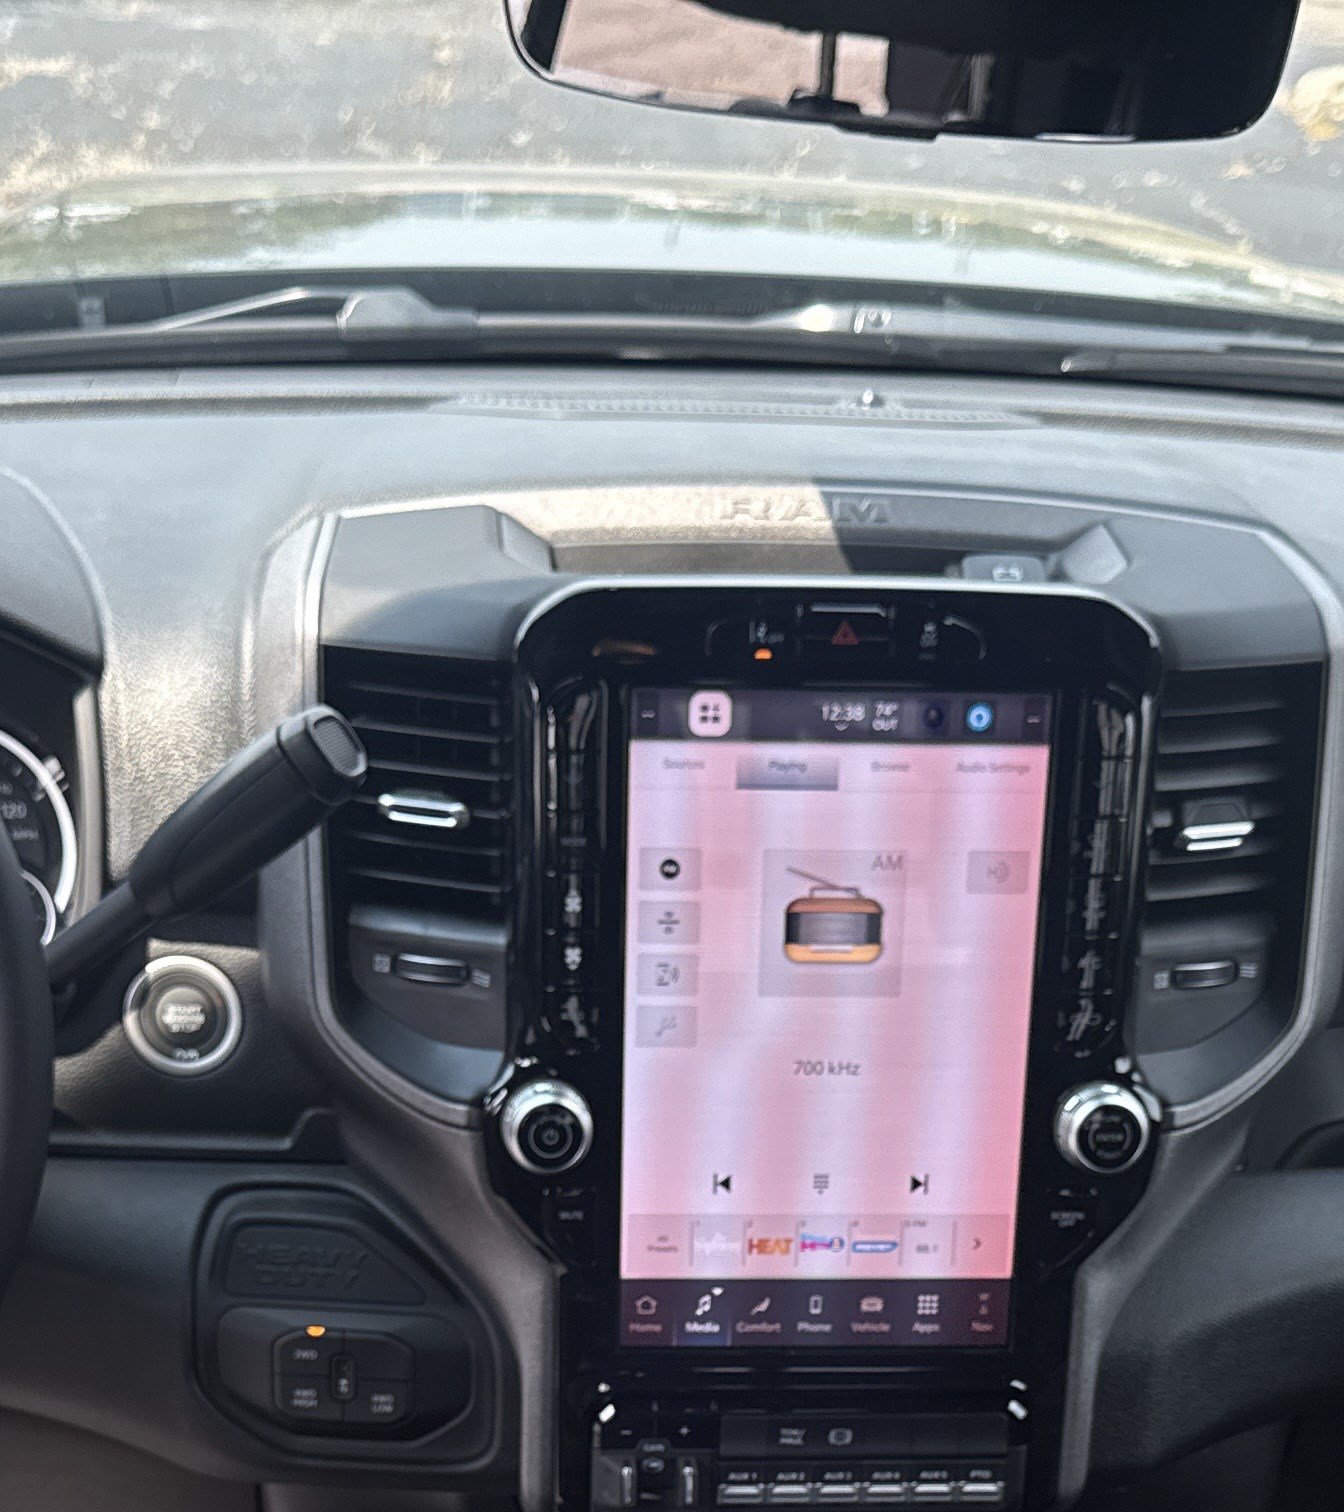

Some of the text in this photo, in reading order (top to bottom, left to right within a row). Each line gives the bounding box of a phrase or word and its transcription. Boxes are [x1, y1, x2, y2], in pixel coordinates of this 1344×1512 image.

[719, 496, 890, 524] RAM
[871, 853, 905, 872] AM
[793, 1059, 862, 1077] 700 kHz
[747, 1237, 794, 1256] HEAT
